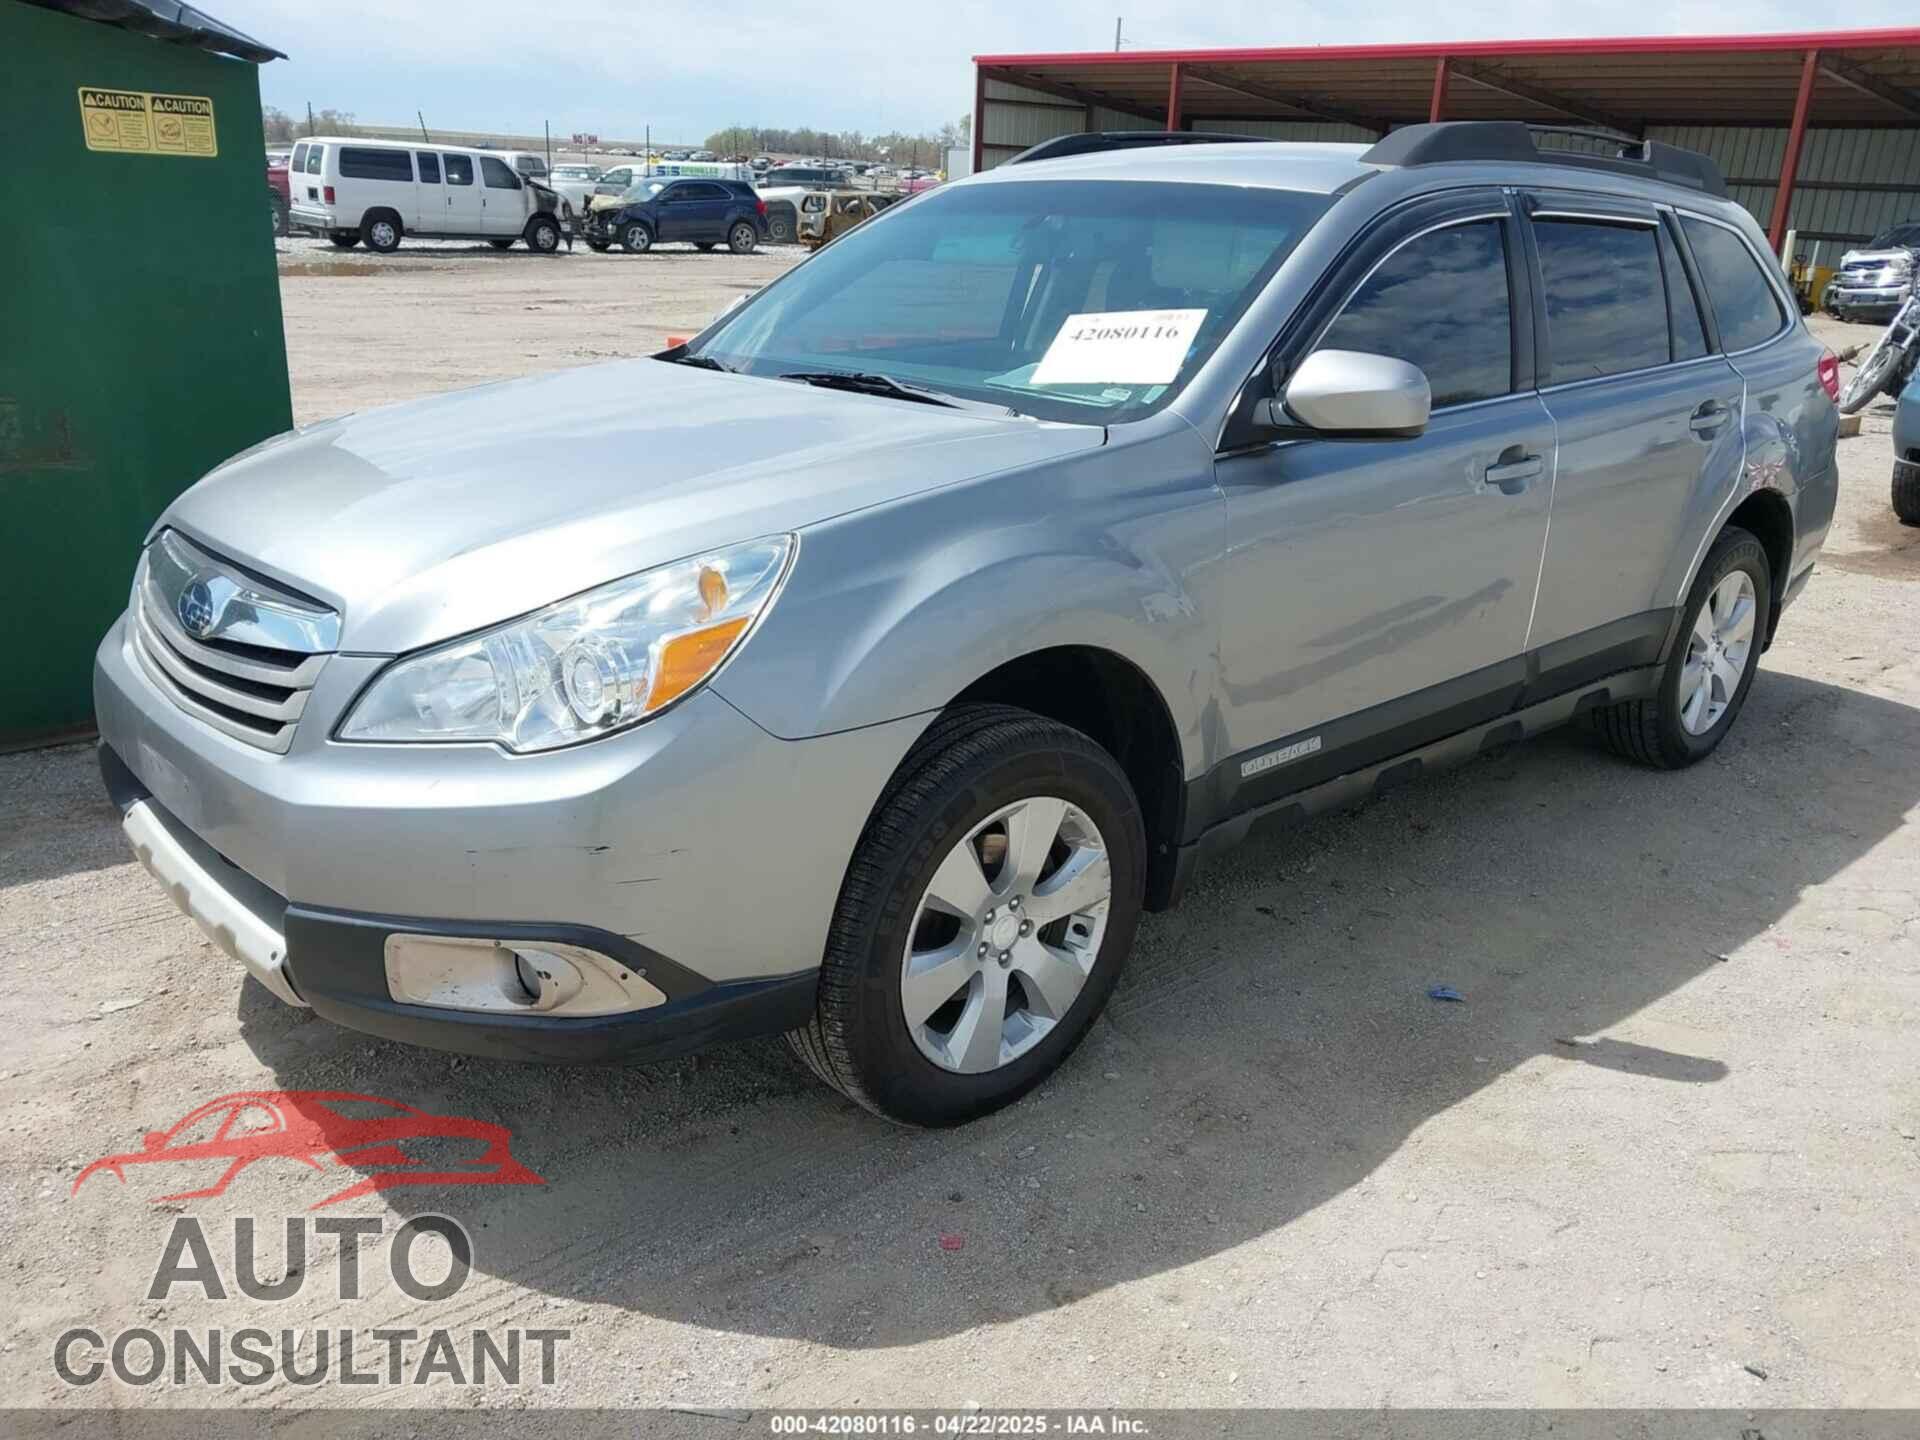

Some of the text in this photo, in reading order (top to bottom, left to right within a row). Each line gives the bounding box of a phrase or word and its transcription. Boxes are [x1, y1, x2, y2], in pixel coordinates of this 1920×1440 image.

[96, 94, 145, 109] CAUTION
[164, 101, 210, 114] CAUTION
[1071, 326, 1179, 341] 42080116
